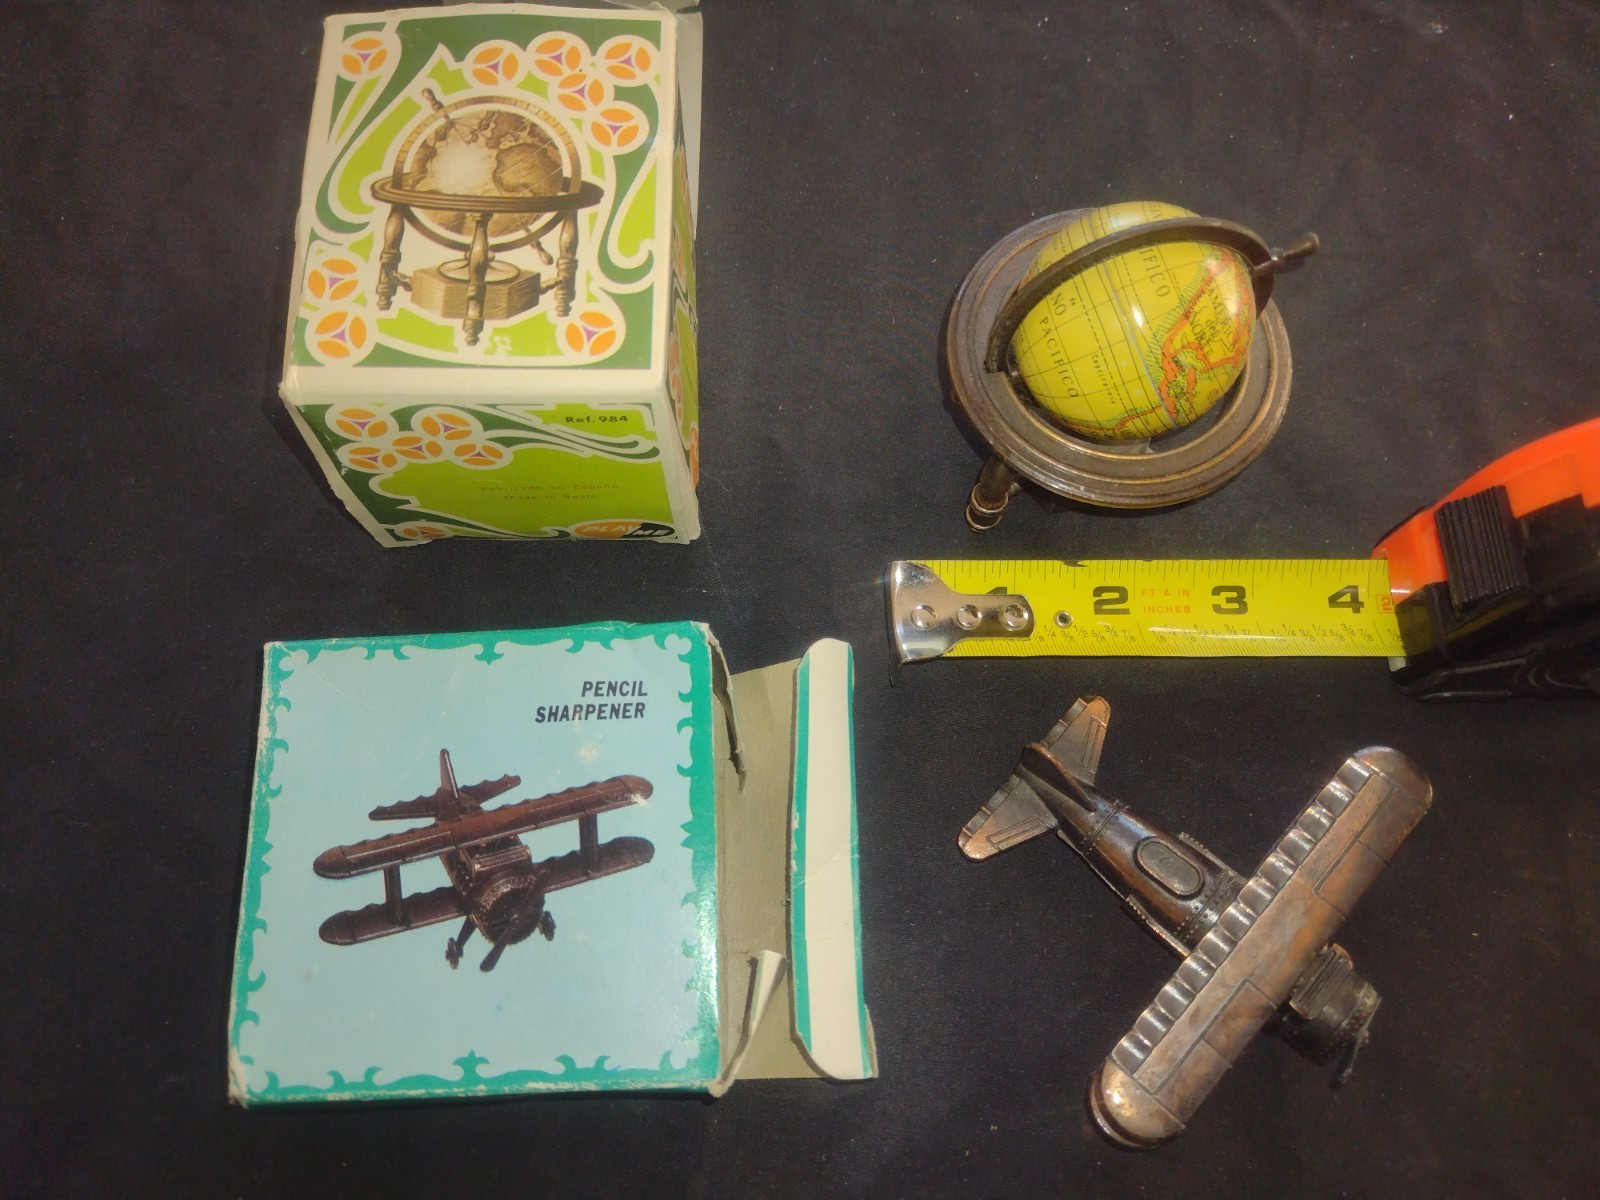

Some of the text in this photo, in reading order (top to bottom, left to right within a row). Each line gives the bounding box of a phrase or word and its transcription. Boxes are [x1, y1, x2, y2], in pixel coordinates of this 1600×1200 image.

[1039, 316, 1079, 398] PACIFICO
[1093, 586, 1130, 615] 2
[1141, 589, 1190, 598] FT & IN
[1211, 585, 1248, 615] 3
[1328, 585, 1364, 614] 4
[1143, 605, 1191, 614] INCHES
[581, 680, 648, 697] PENCIL
[535, 702, 646, 723] SHARPENER
